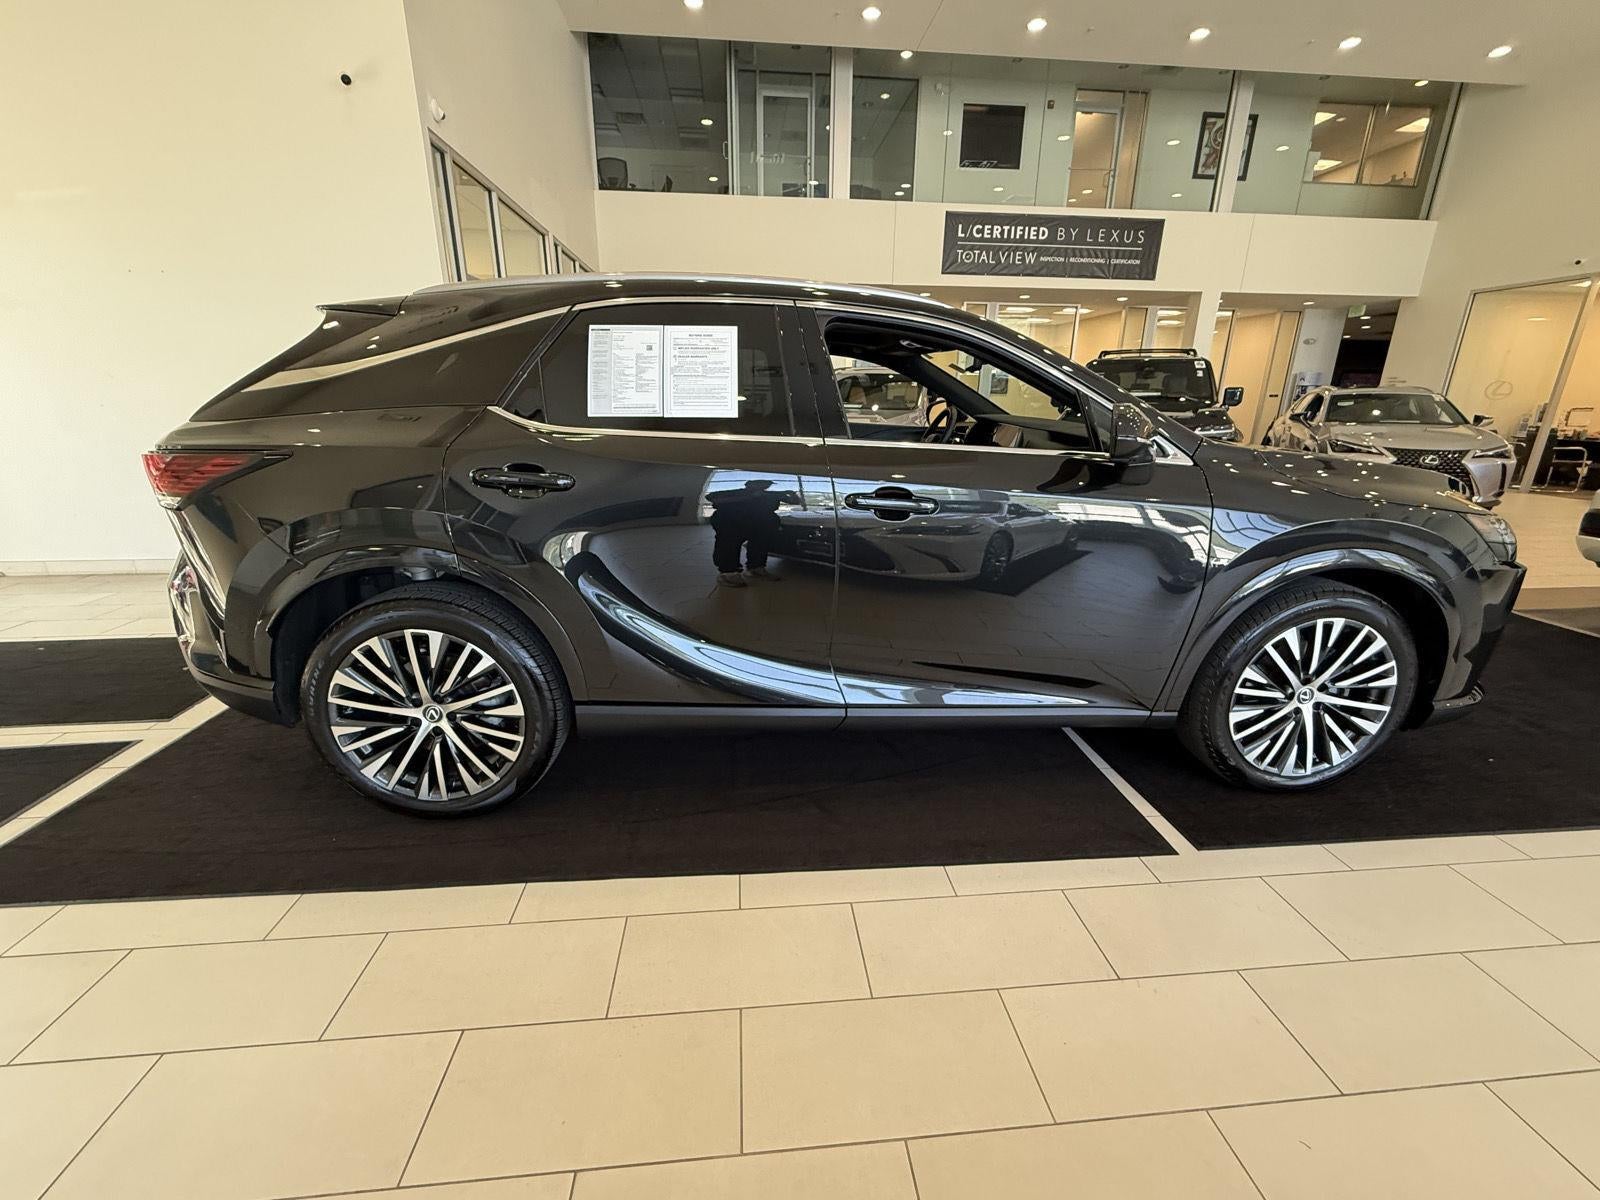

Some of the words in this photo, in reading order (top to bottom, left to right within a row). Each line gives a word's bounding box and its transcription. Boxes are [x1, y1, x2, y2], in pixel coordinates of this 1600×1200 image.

[957, 223, 1049, 240] L/CERTIFIED
[1056, 227, 1079, 241] BY
[1086, 228, 1145, 244] LEXUS
[956, 249, 996, 264] TOTAL
[999, 250, 1038, 265] VIEW
